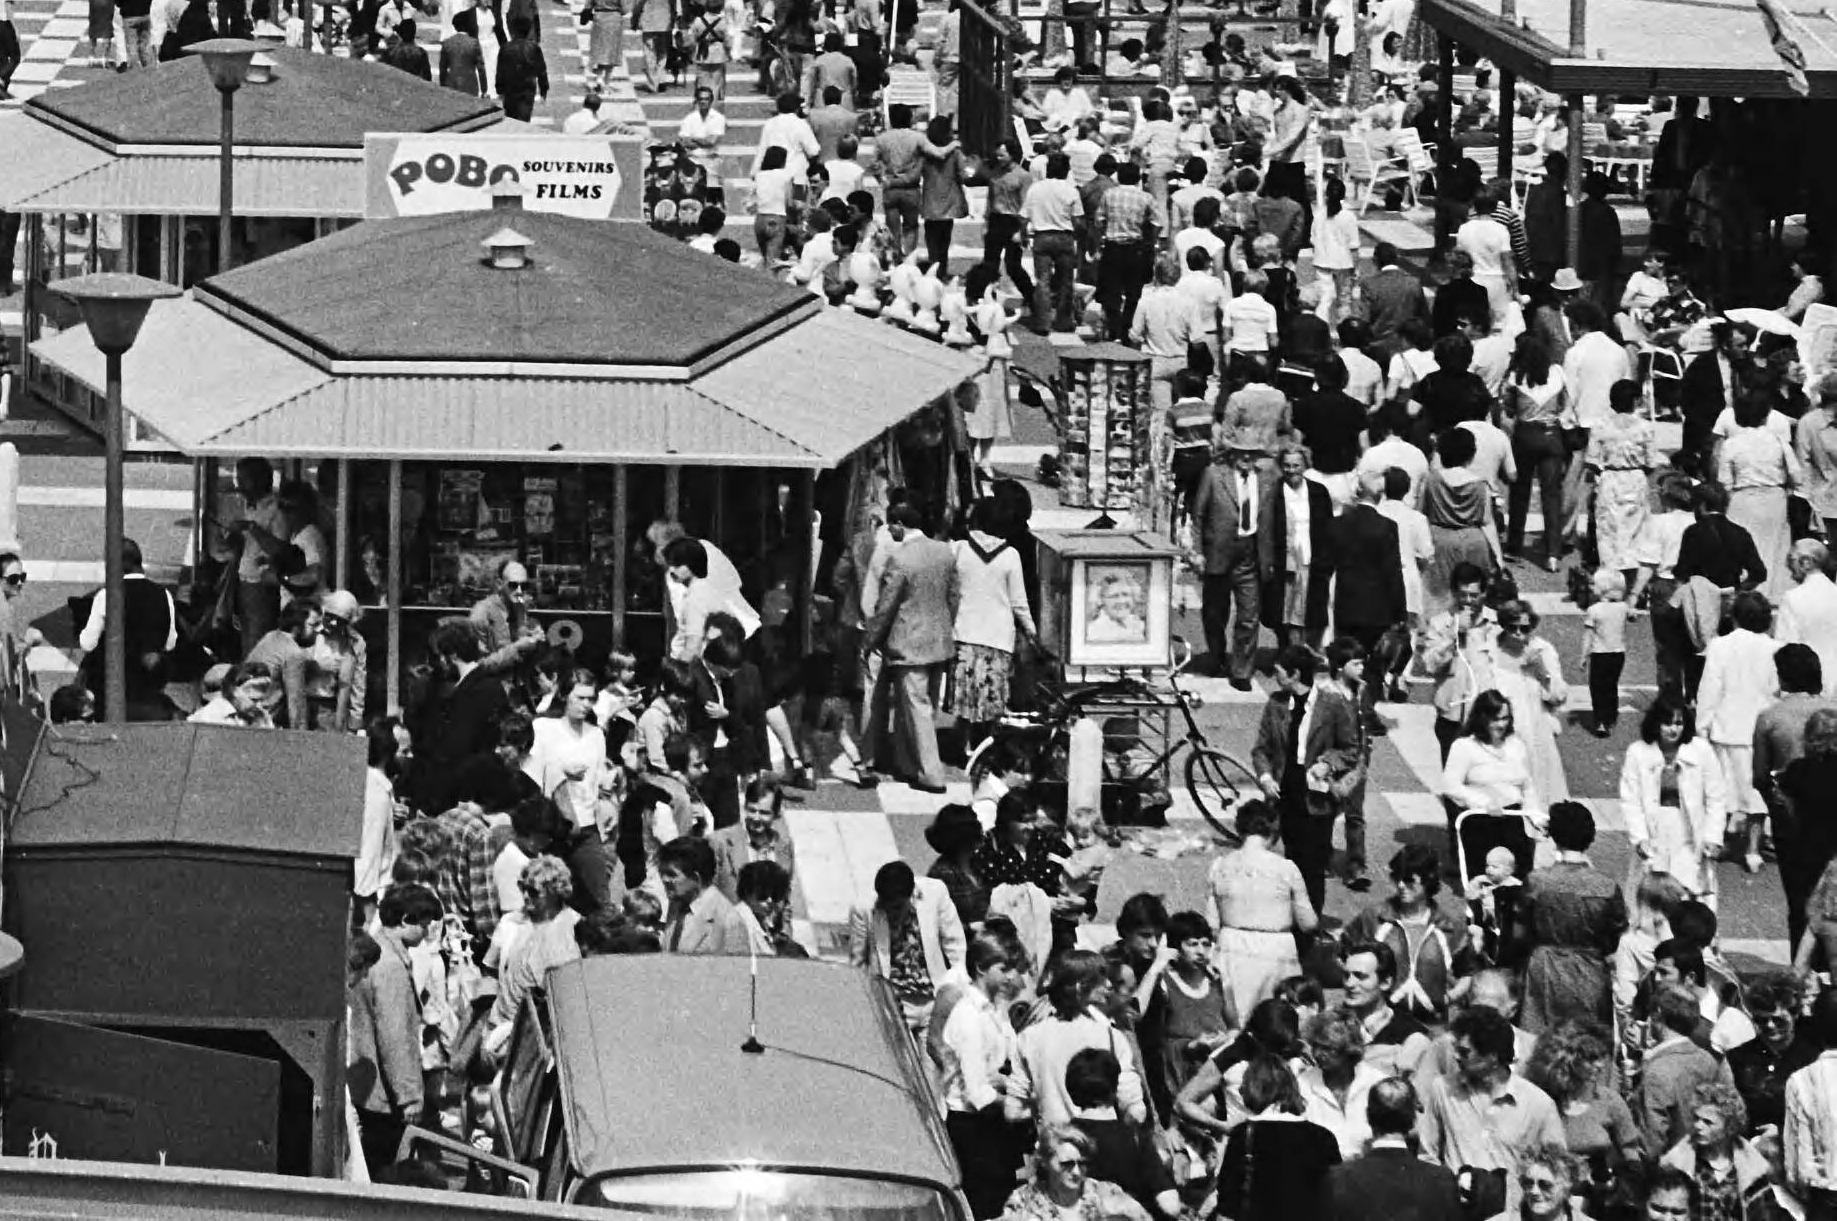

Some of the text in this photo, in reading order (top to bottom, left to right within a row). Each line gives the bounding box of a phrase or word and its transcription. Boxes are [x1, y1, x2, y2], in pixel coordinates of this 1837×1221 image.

[390, 153, 614, 196] POBO SOUVENIRS
[536, 184, 602, 199] FILMS
